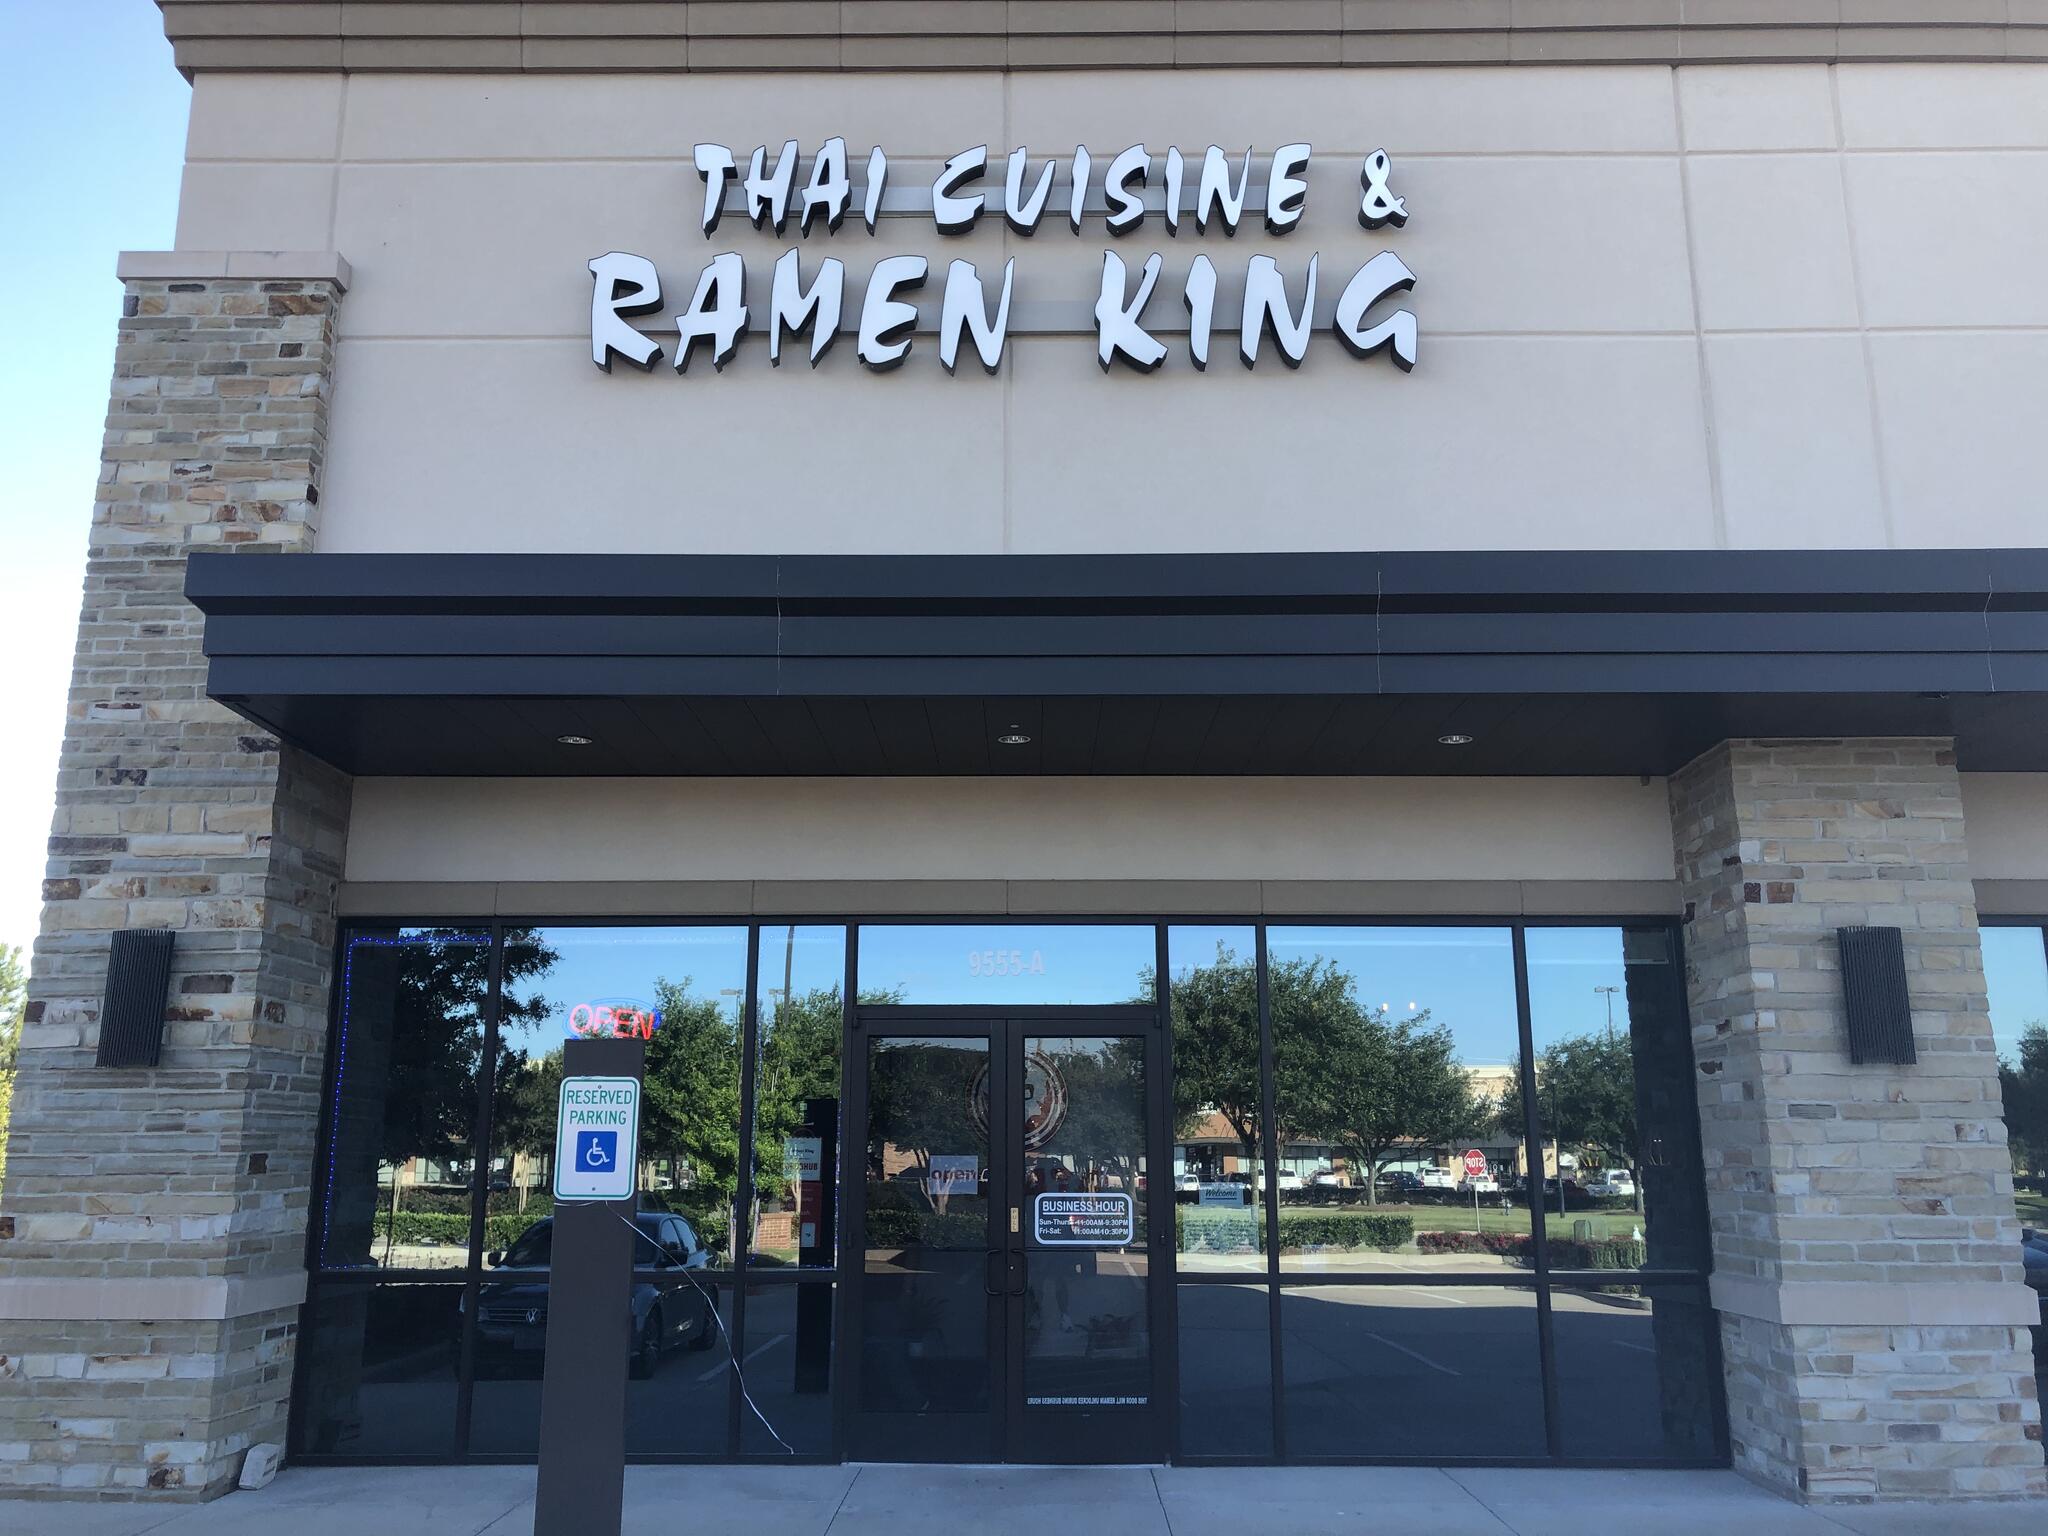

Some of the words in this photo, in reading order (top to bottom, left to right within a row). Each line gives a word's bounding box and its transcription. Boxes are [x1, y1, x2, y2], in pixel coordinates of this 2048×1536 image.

[694, 137, 887, 240] THAI
[931, 142, 1311, 238] CUISINE
[1359, 147, 1408, 230] &
[588, 246, 1014, 376] RAMEN
[1094, 249, 1417, 373] KING
[968, 950, 1046, 977] 9555-A
[569, 1004, 655, 1040] OPEN
[567, 1090, 633, 1105] RESERVED
[569, 1110, 627, 1125] PARKING
[931, 1169, 977, 1183] open
[1205, 1188, 1238, 1197] Welcome
[1042, 1200, 1093, 1212] BUSINESS
[1095, 1200, 1125, 1212] HOUR
